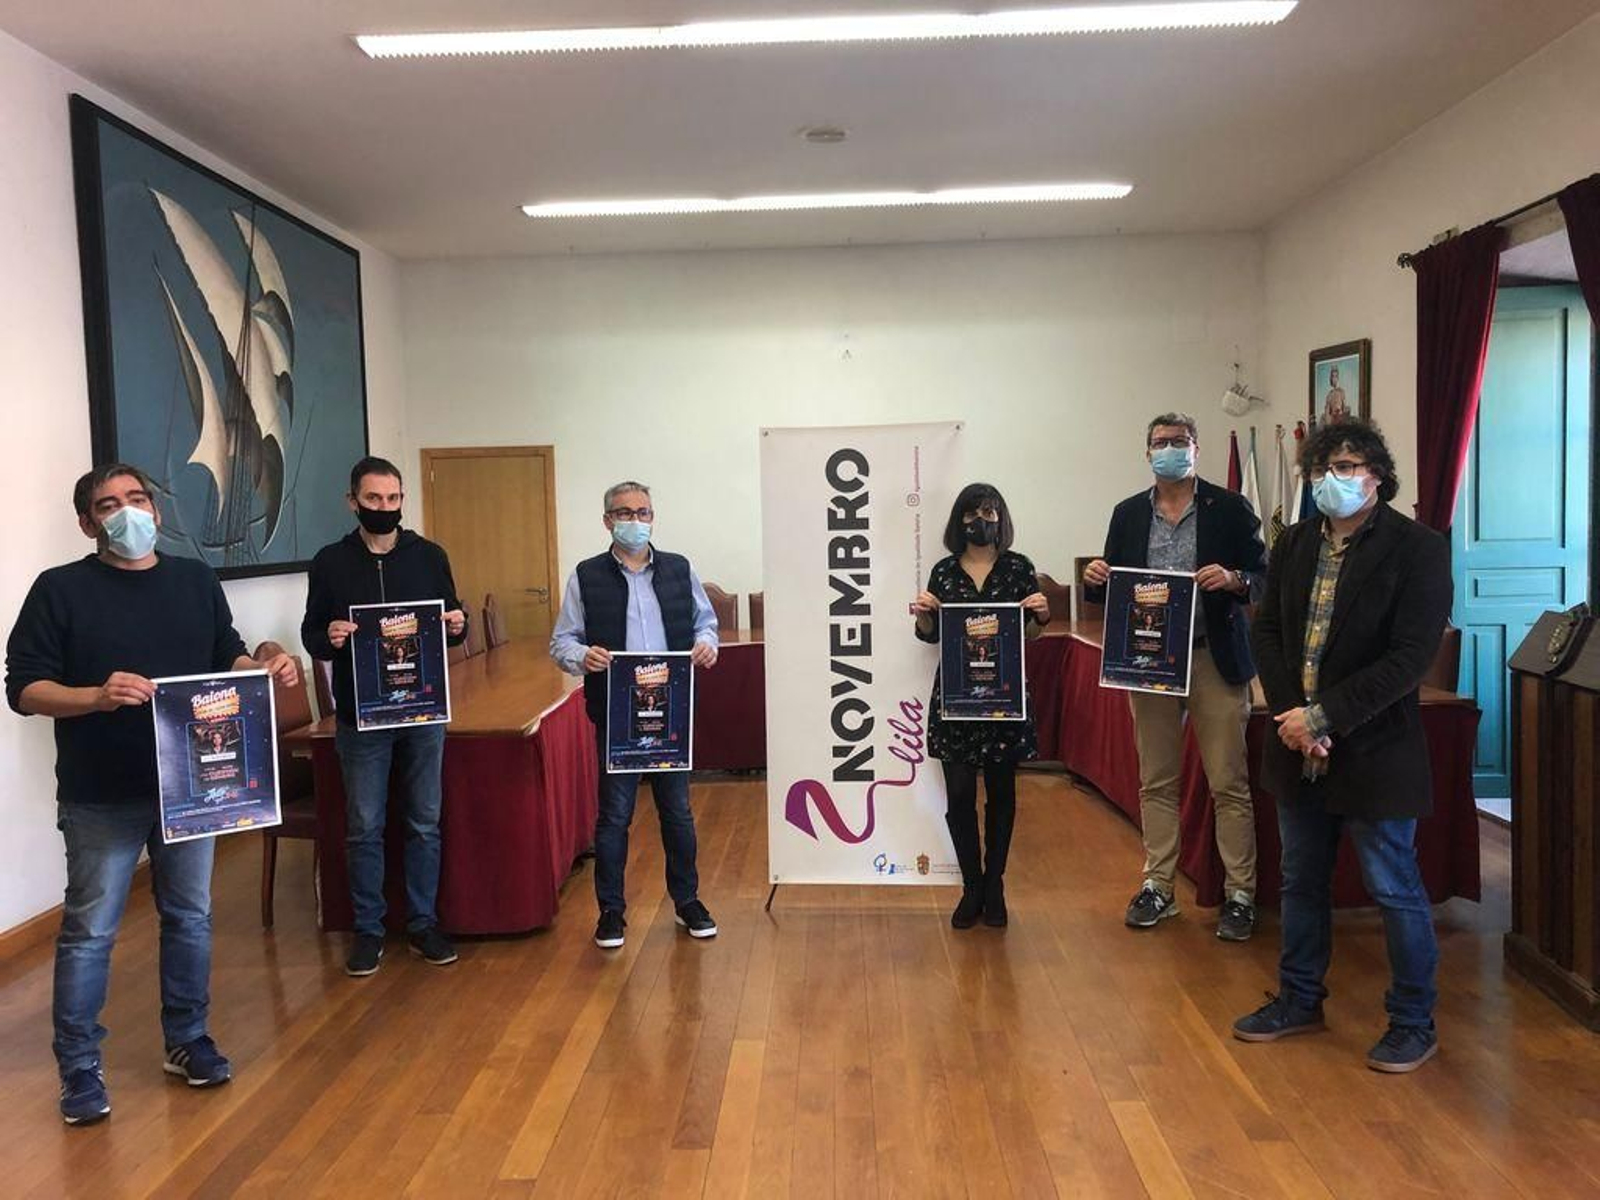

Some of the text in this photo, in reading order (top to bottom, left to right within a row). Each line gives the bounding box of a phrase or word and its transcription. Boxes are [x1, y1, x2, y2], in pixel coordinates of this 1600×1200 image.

[825, 447, 876, 783] NOVEMBRO
[190, 686, 237, 709] Baiona
[887, 695, 924, 765] lila
